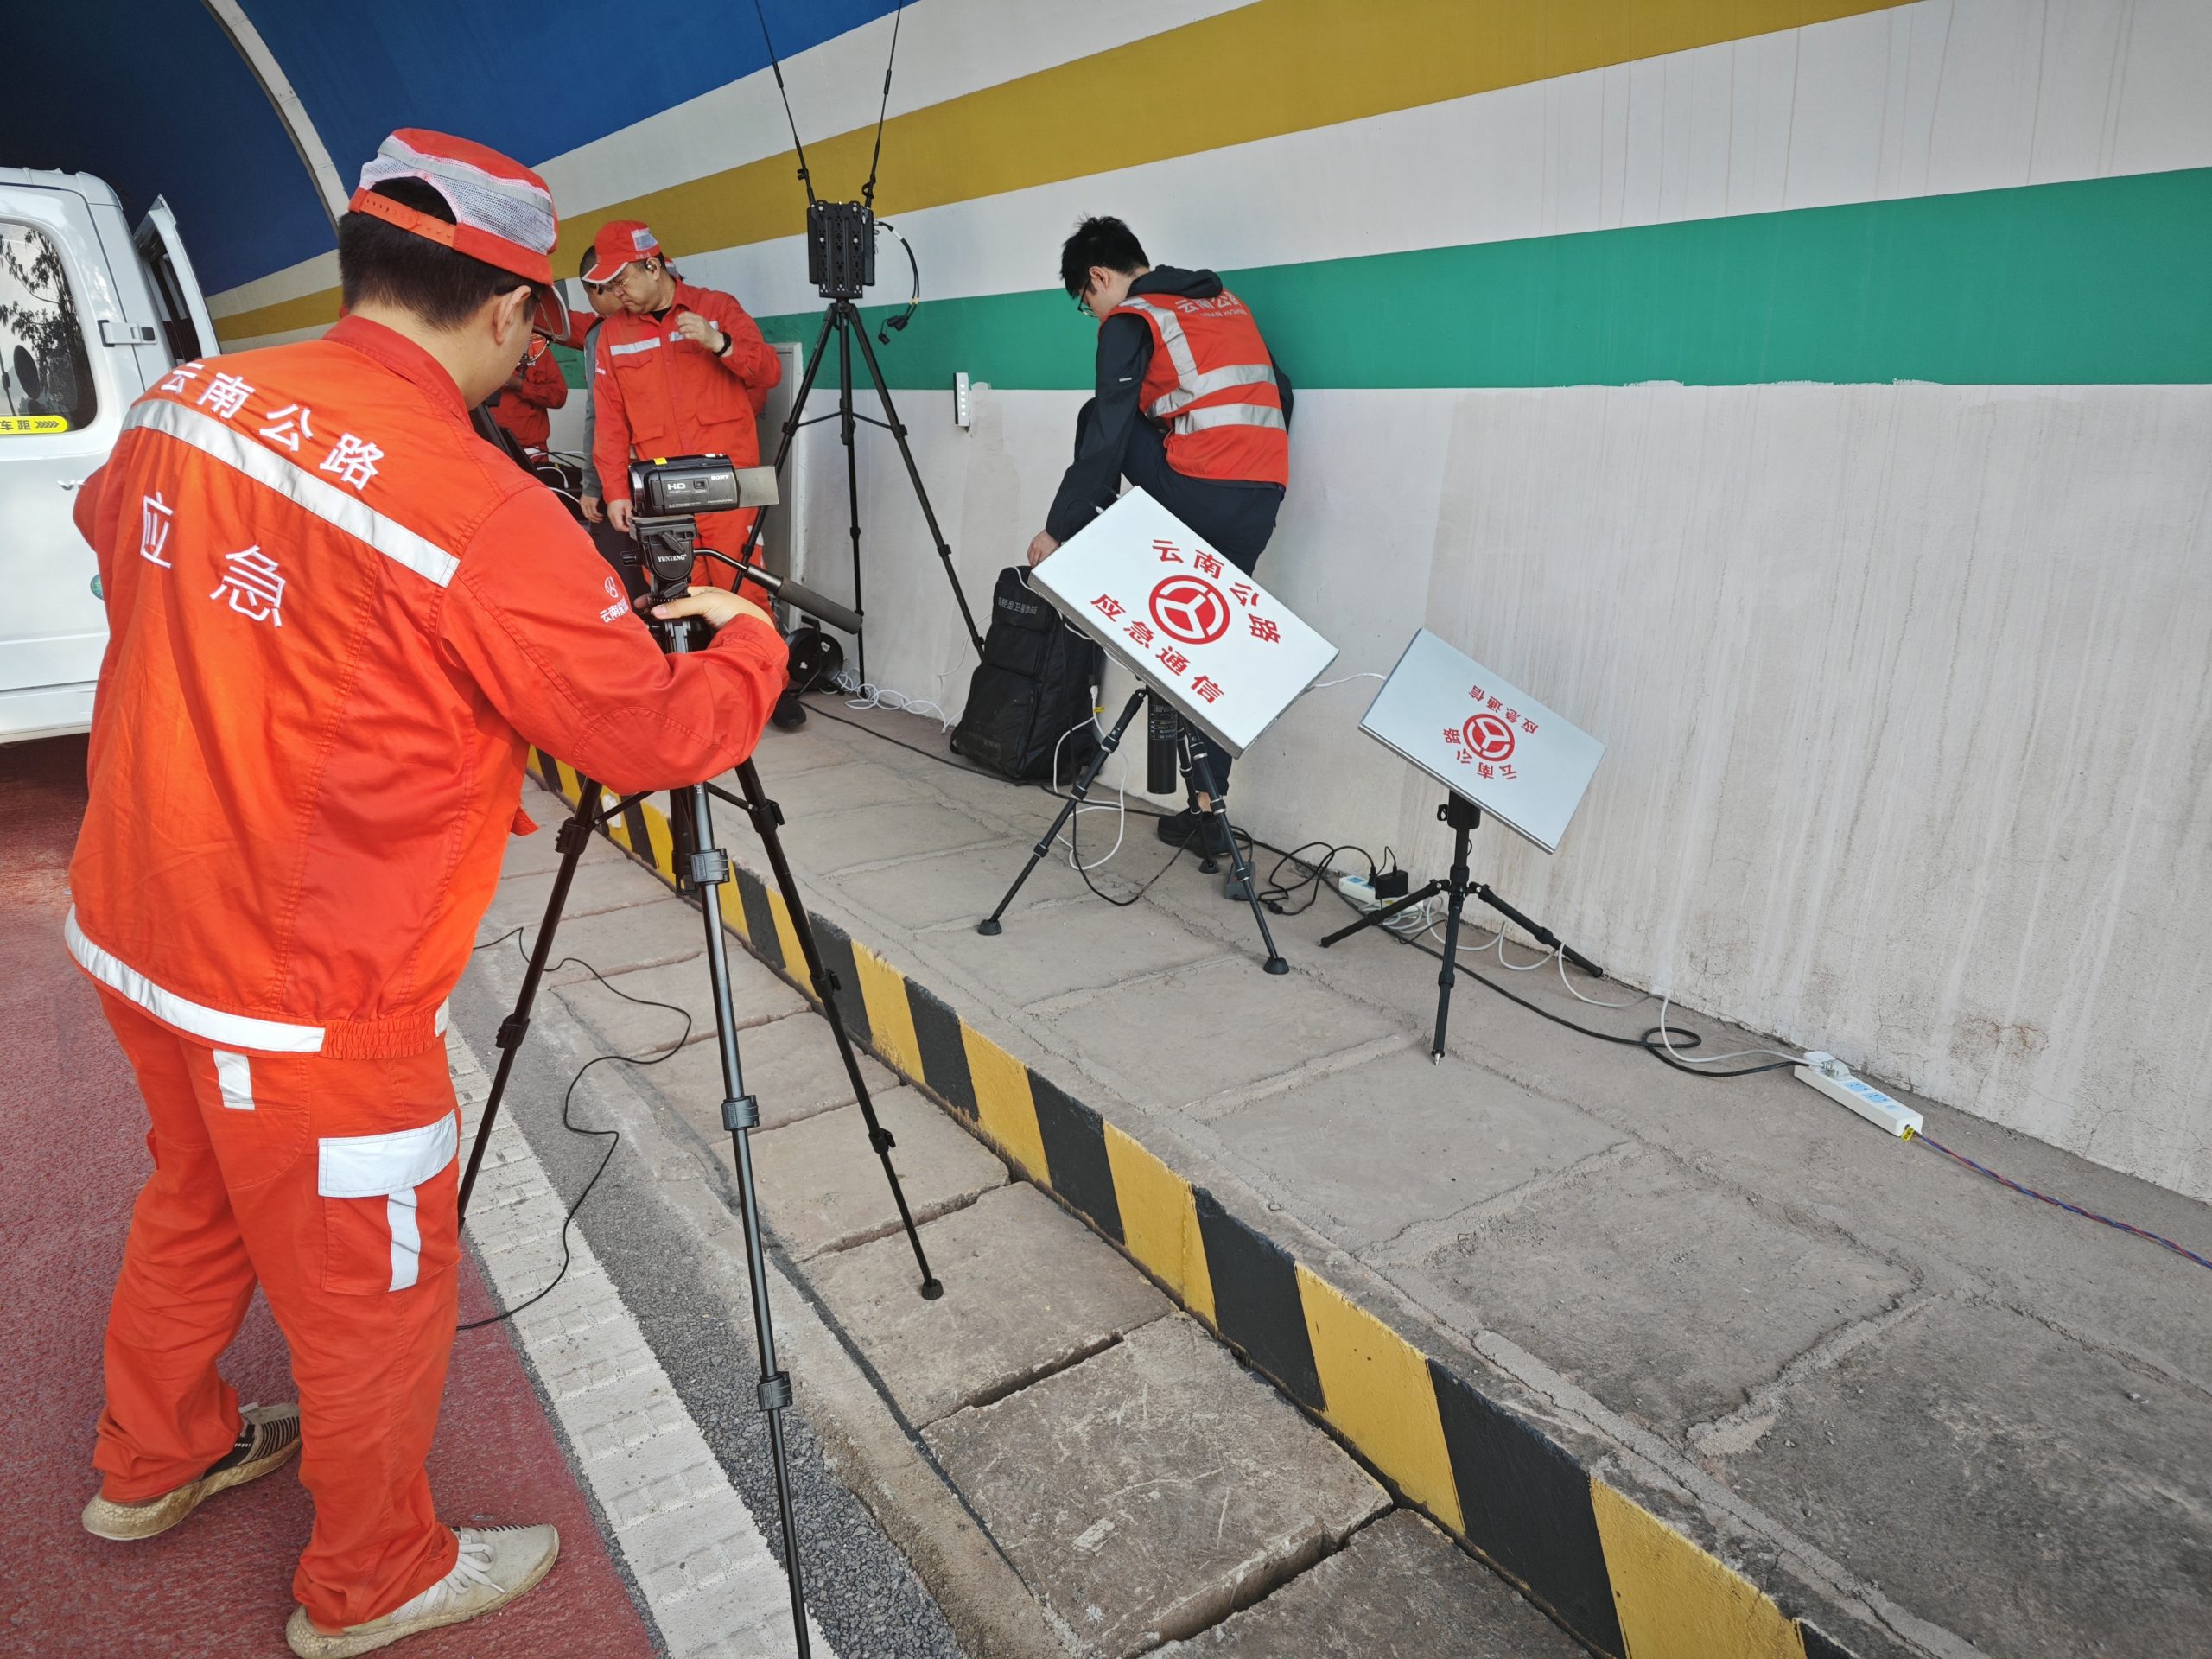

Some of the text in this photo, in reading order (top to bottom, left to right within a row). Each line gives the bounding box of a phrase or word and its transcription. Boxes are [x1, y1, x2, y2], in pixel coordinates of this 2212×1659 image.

[0, 420, 31, 430] 车距
[161, 362, 385, 491] 云南公路
[667, 482, 686, 491] HD
[140, 491, 286, 627] 应急
[1152, 539, 1281, 645] 云南公路
[1090, 594, 1225, 704] 应急通信
[1468, 684, 1539, 734] 应急通信
[1443, 728, 1517, 780] 云南公路
